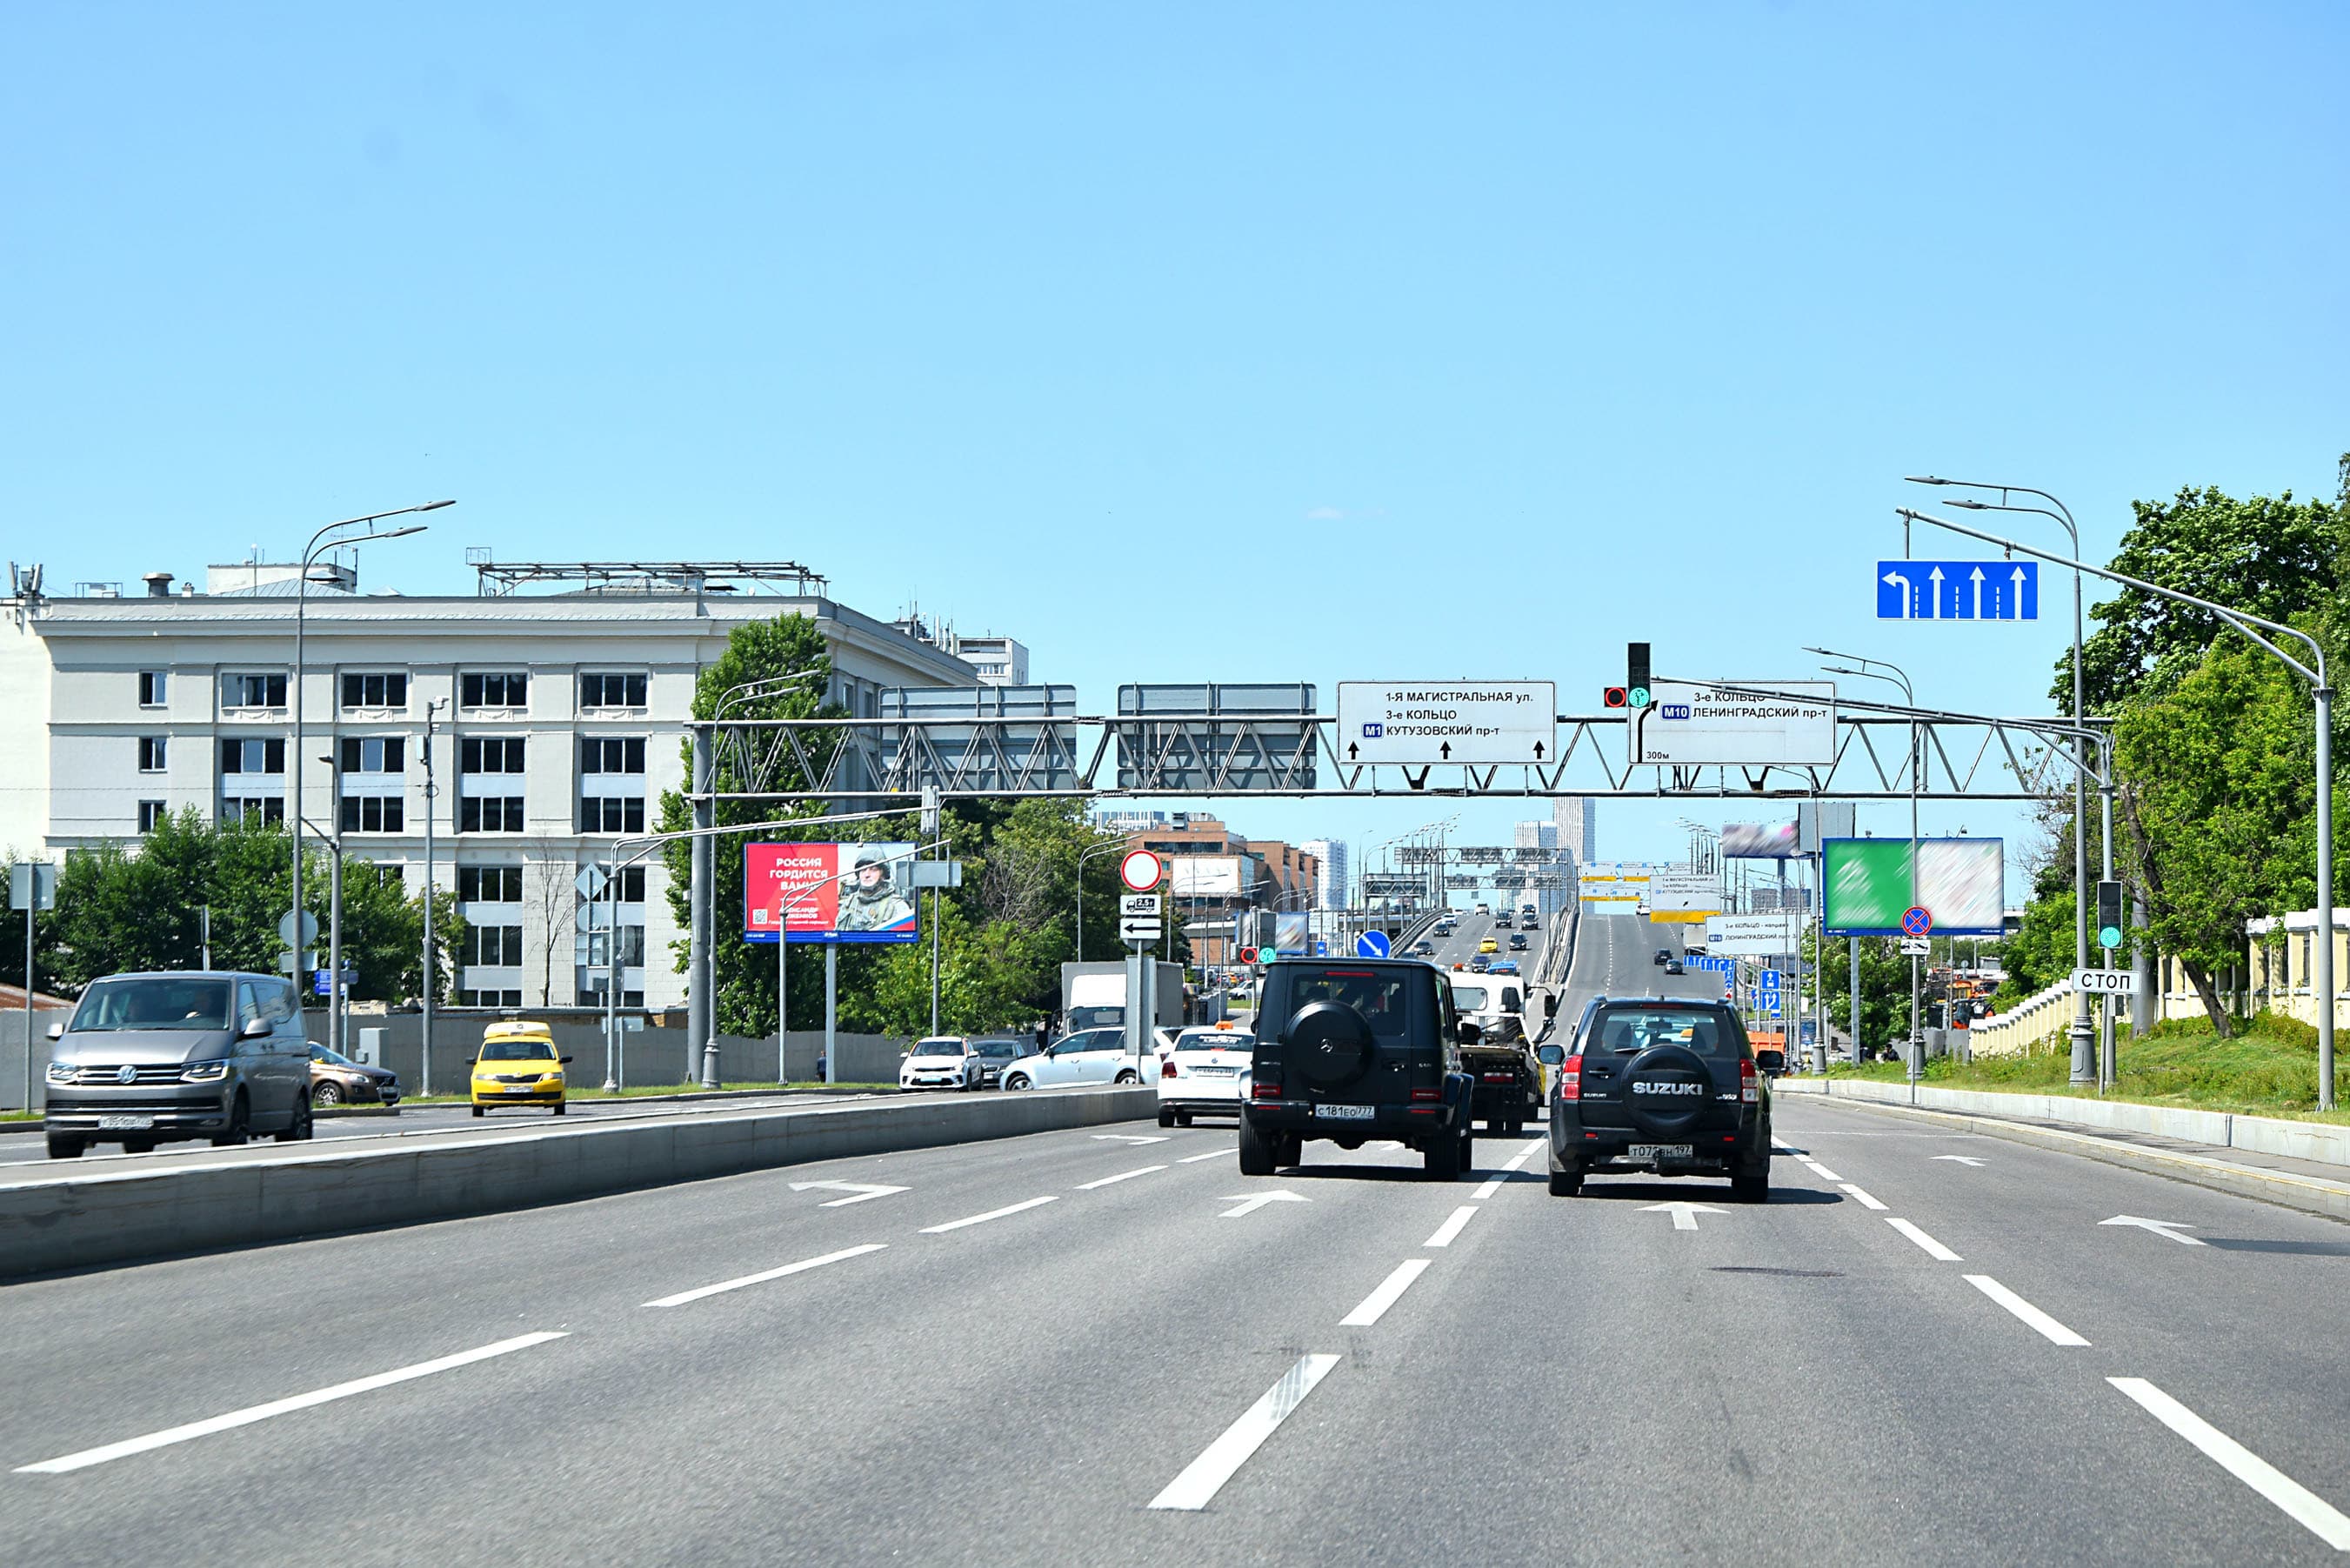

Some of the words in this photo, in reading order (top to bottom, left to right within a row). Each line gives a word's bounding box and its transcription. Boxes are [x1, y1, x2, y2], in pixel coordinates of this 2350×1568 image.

[1385, 692, 1403, 702] 1-Я
[1406, 692, 1513, 702] МАГИСТРАЛЬНАЯ
[1516, 693, 1533, 704] ул.
[1693, 692, 1712, 702] 3-е
[1714, 691, 1766, 704] КОЛЬЦО
[1386, 711, 1403, 720] 3-е
[1406, 710, 1458, 721] КОЛЬЦО
[1692, 704, 1799, 718] ЛЕНИНГРАДСКИЙ
[1803, 710, 1827, 720] пр-т
[1386, 724, 1472, 736] КУТУЗОВСКИЙ
[1476, 728, 1500, 737] пр-т
[776, 857, 822, 867] РОССИЯ
[769, 870, 828, 879] ГОРДИТСЯ
[780, 881, 815, 891] ВАМ
[2081, 973, 2130, 990] СТОП
[1632, 1082, 1703, 1096] SUZUKI
